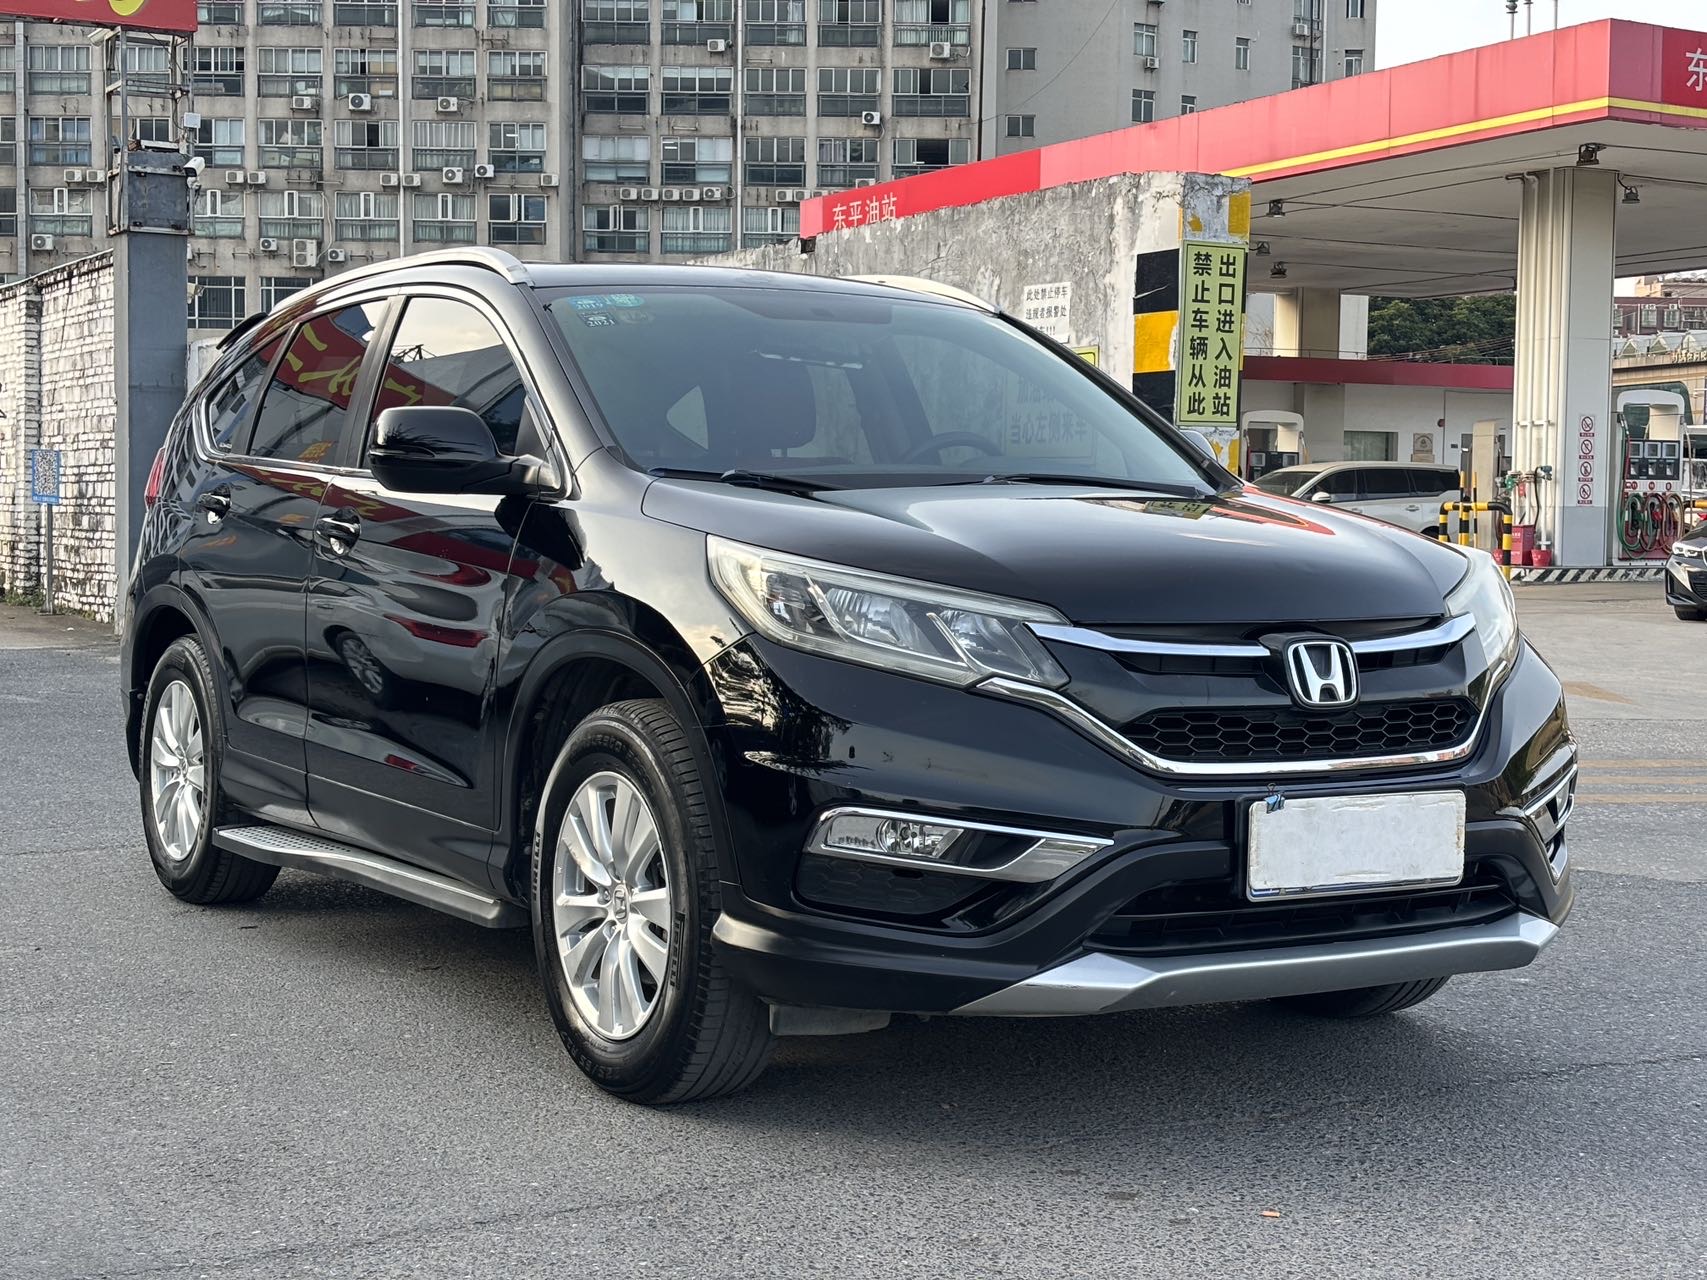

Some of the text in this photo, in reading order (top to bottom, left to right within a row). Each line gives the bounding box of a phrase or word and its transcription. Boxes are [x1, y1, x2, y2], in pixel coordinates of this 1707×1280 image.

[832, 192, 897, 231] 东平油站
[1026, 286, 1068, 301] 此处禁止停车
[1186, 250, 1213, 417] 禁止车辆从此
[1211, 252, 1237, 417] 出口进入油站
